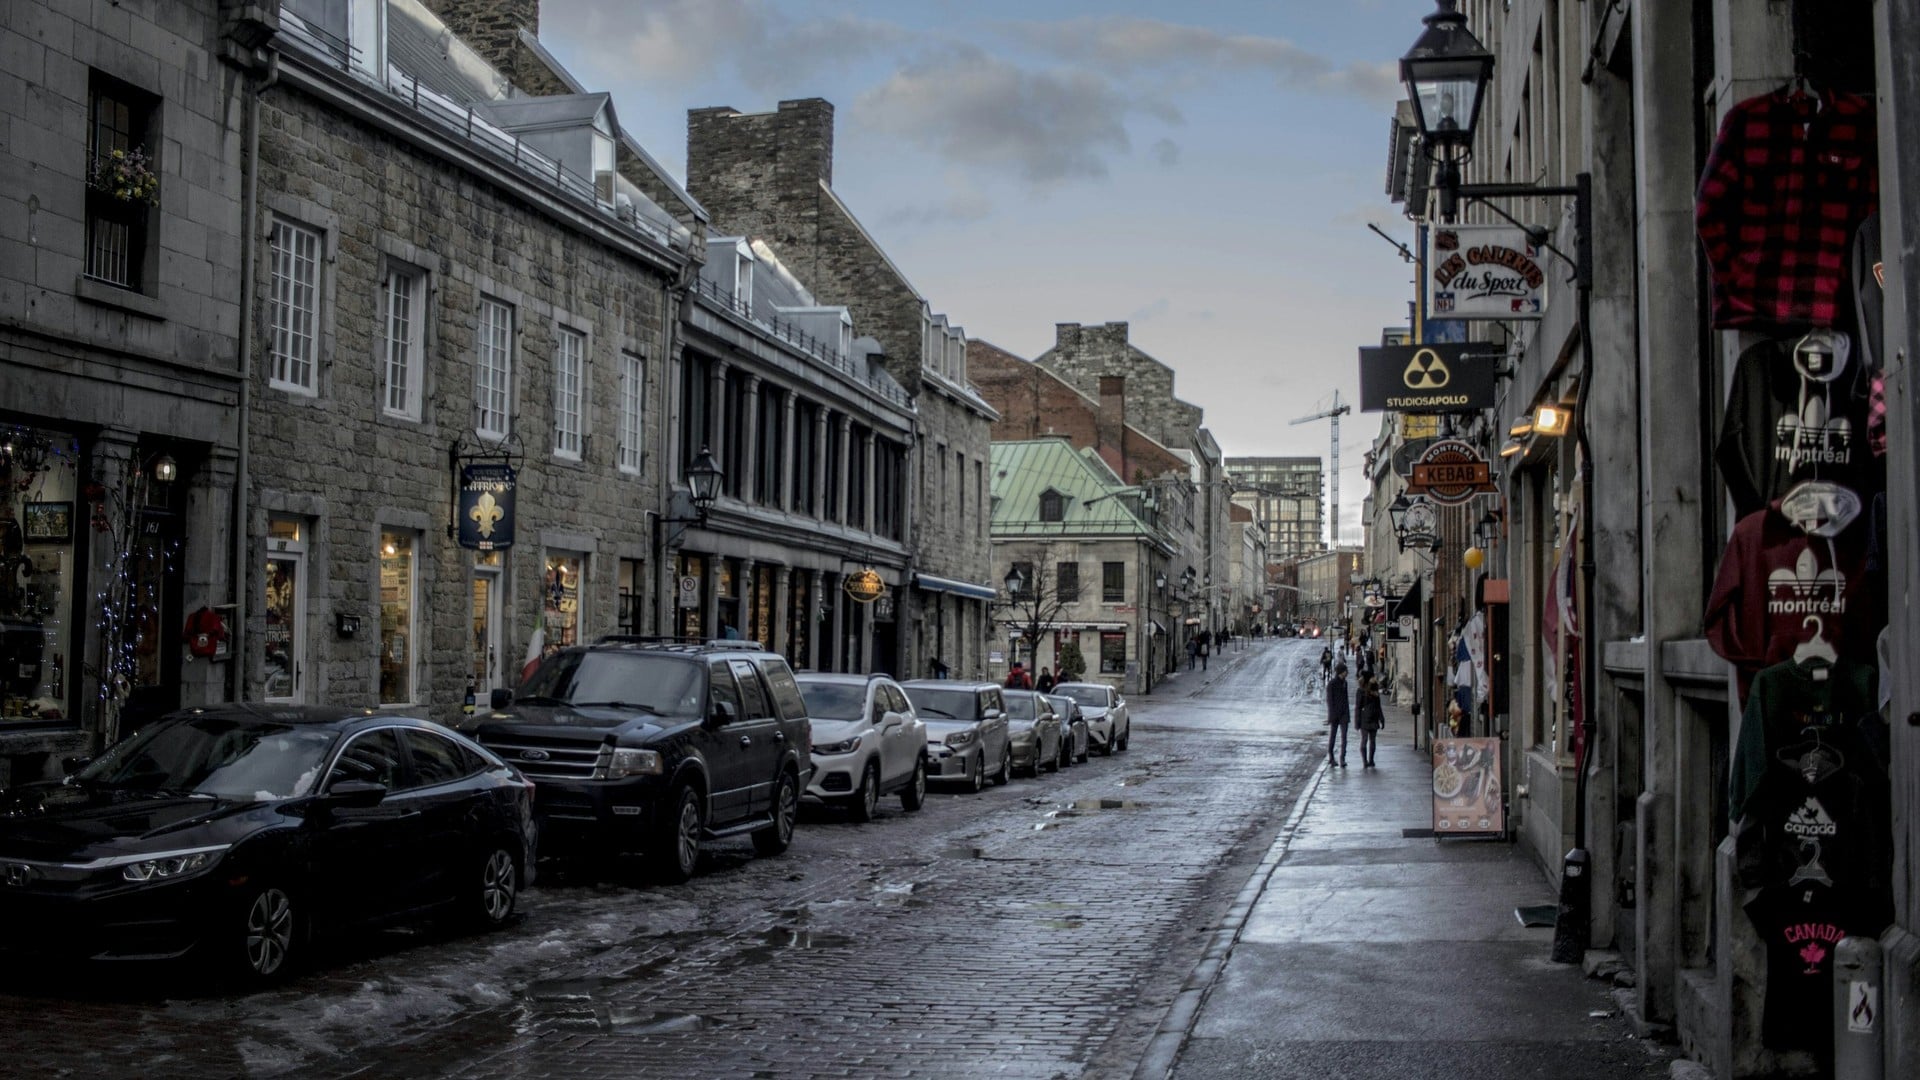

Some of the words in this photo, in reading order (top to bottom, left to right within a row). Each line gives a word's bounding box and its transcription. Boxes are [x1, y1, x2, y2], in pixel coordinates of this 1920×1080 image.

[1434, 252, 1466, 289] LES
[1466, 244, 1544, 290] GALERIES
[1453, 271, 1478, 290] du
[1478, 271, 1525, 297] Sport
[1436, 299, 1454, 310] NFL
[1426, 444, 1475, 463] MONTREAL
[1775, 446, 1851, 464] montréal
[1427, 466, 1475, 483] KEBAB
[145, 521, 160, 535] 161
[1768, 598, 1846, 614] montréal
[1783, 820, 1837, 835] canada
[1784, 923, 1846, 944] CANADA
